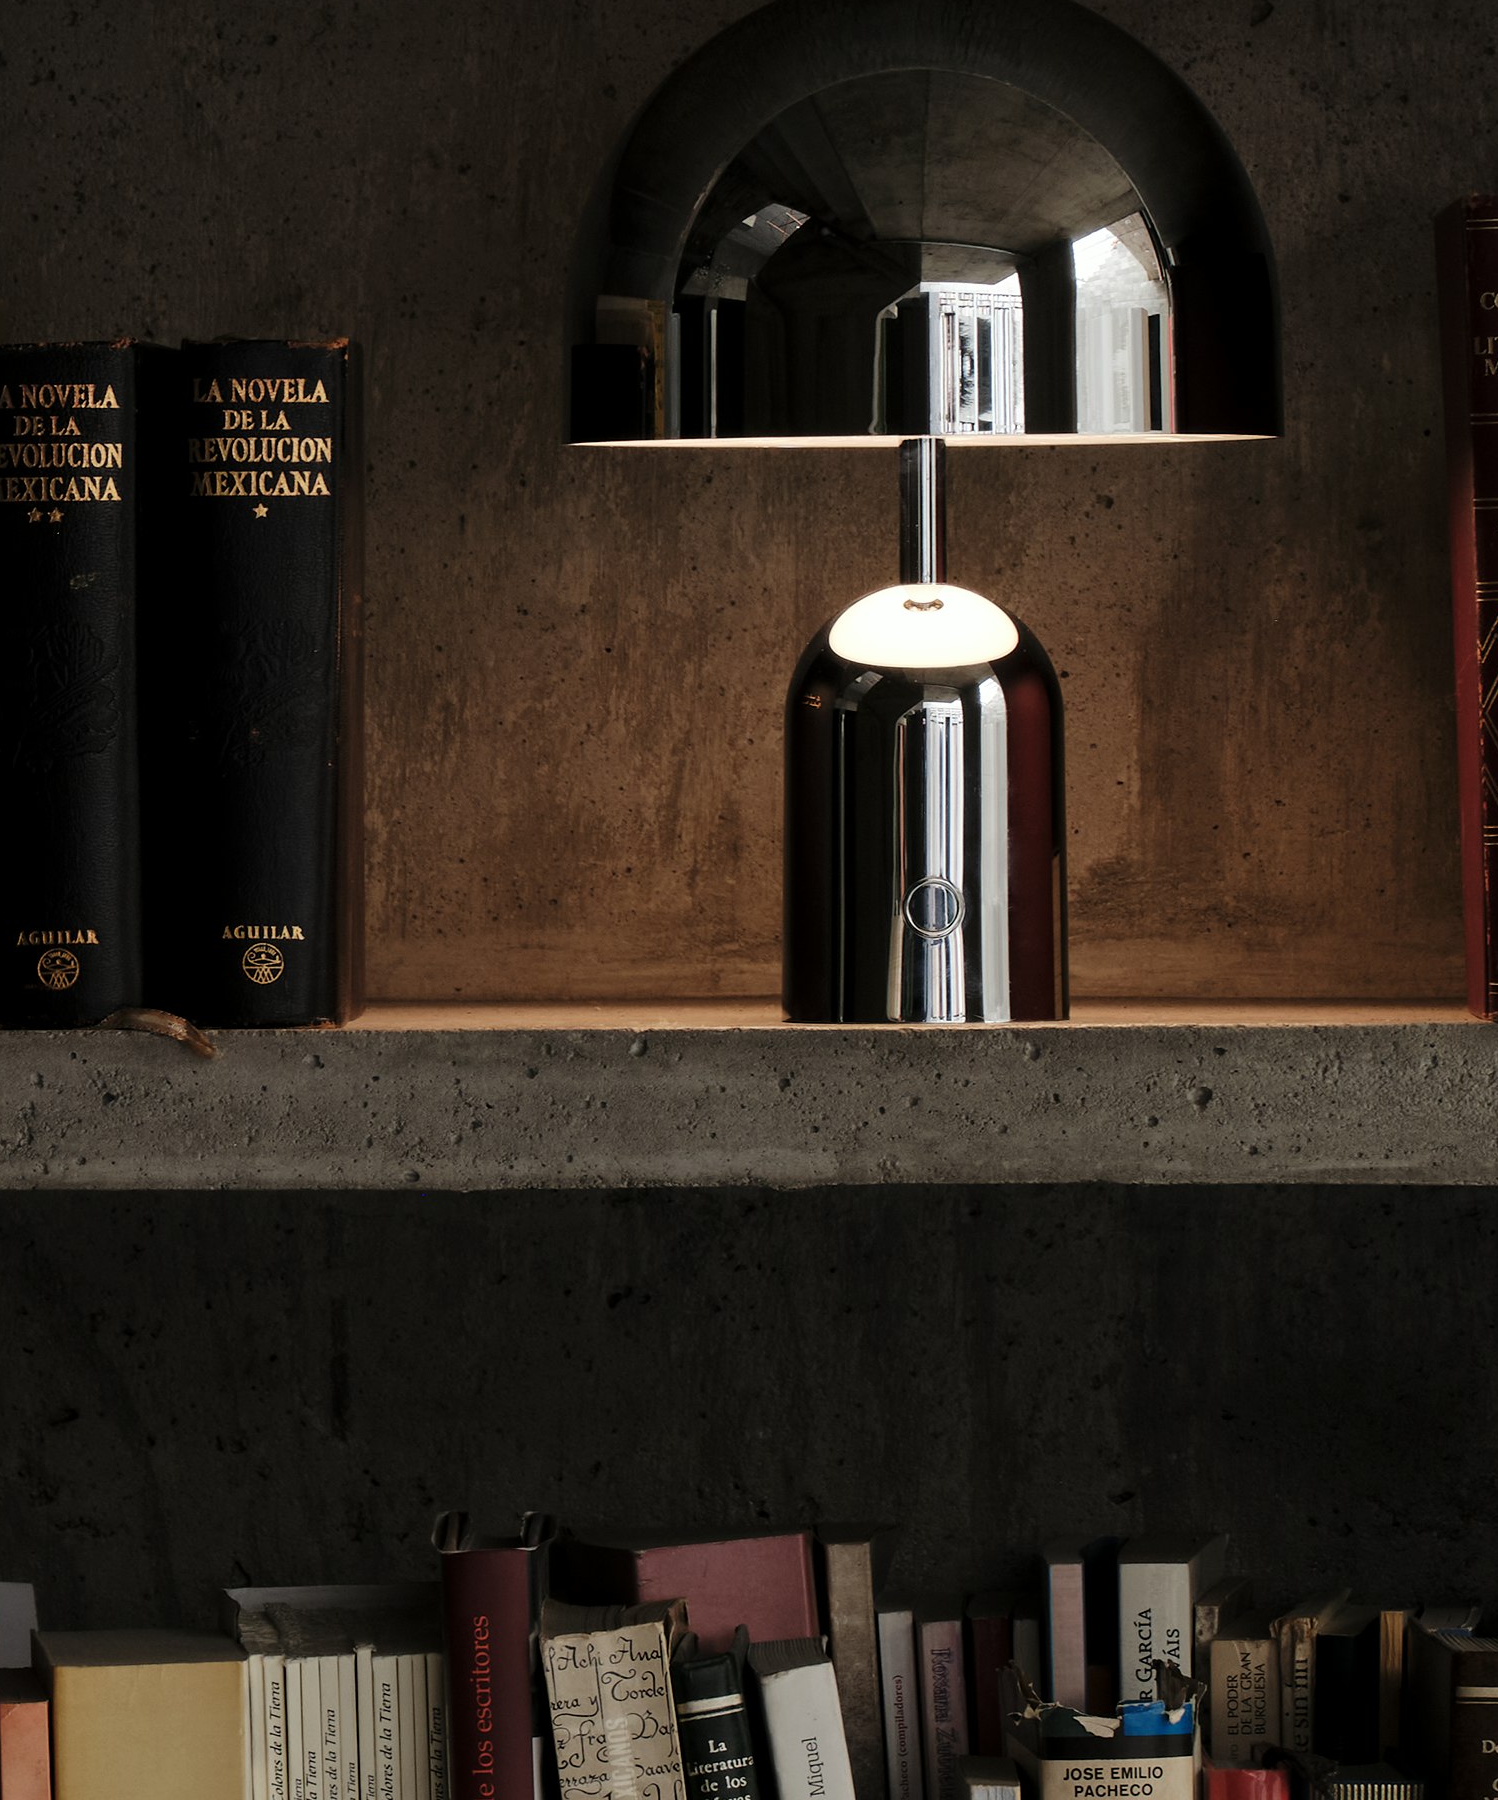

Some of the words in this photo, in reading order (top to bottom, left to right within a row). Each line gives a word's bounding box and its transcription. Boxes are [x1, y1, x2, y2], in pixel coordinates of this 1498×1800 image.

[192, 378, 225, 403] LA
[229, 378, 330, 403] NOVELA
[222, 410, 253, 431] DE
[260, 410, 292, 431] LA
[188, 437, 333, 463] REVOLUCION
[190, 471, 331, 497] MEXICANA
[221, 925, 305, 940] AGUILAR
[471, 1615, 492, 1733] escritores
[472, 1740, 493, 1775] los
[802, 1737, 825, 1797] Miquel
[1064, 1768, 1104, 1781] JOSE
[1111, 1767, 1164, 1779] EMILIO
[1075, 1784, 1153, 1797] PACHECO
